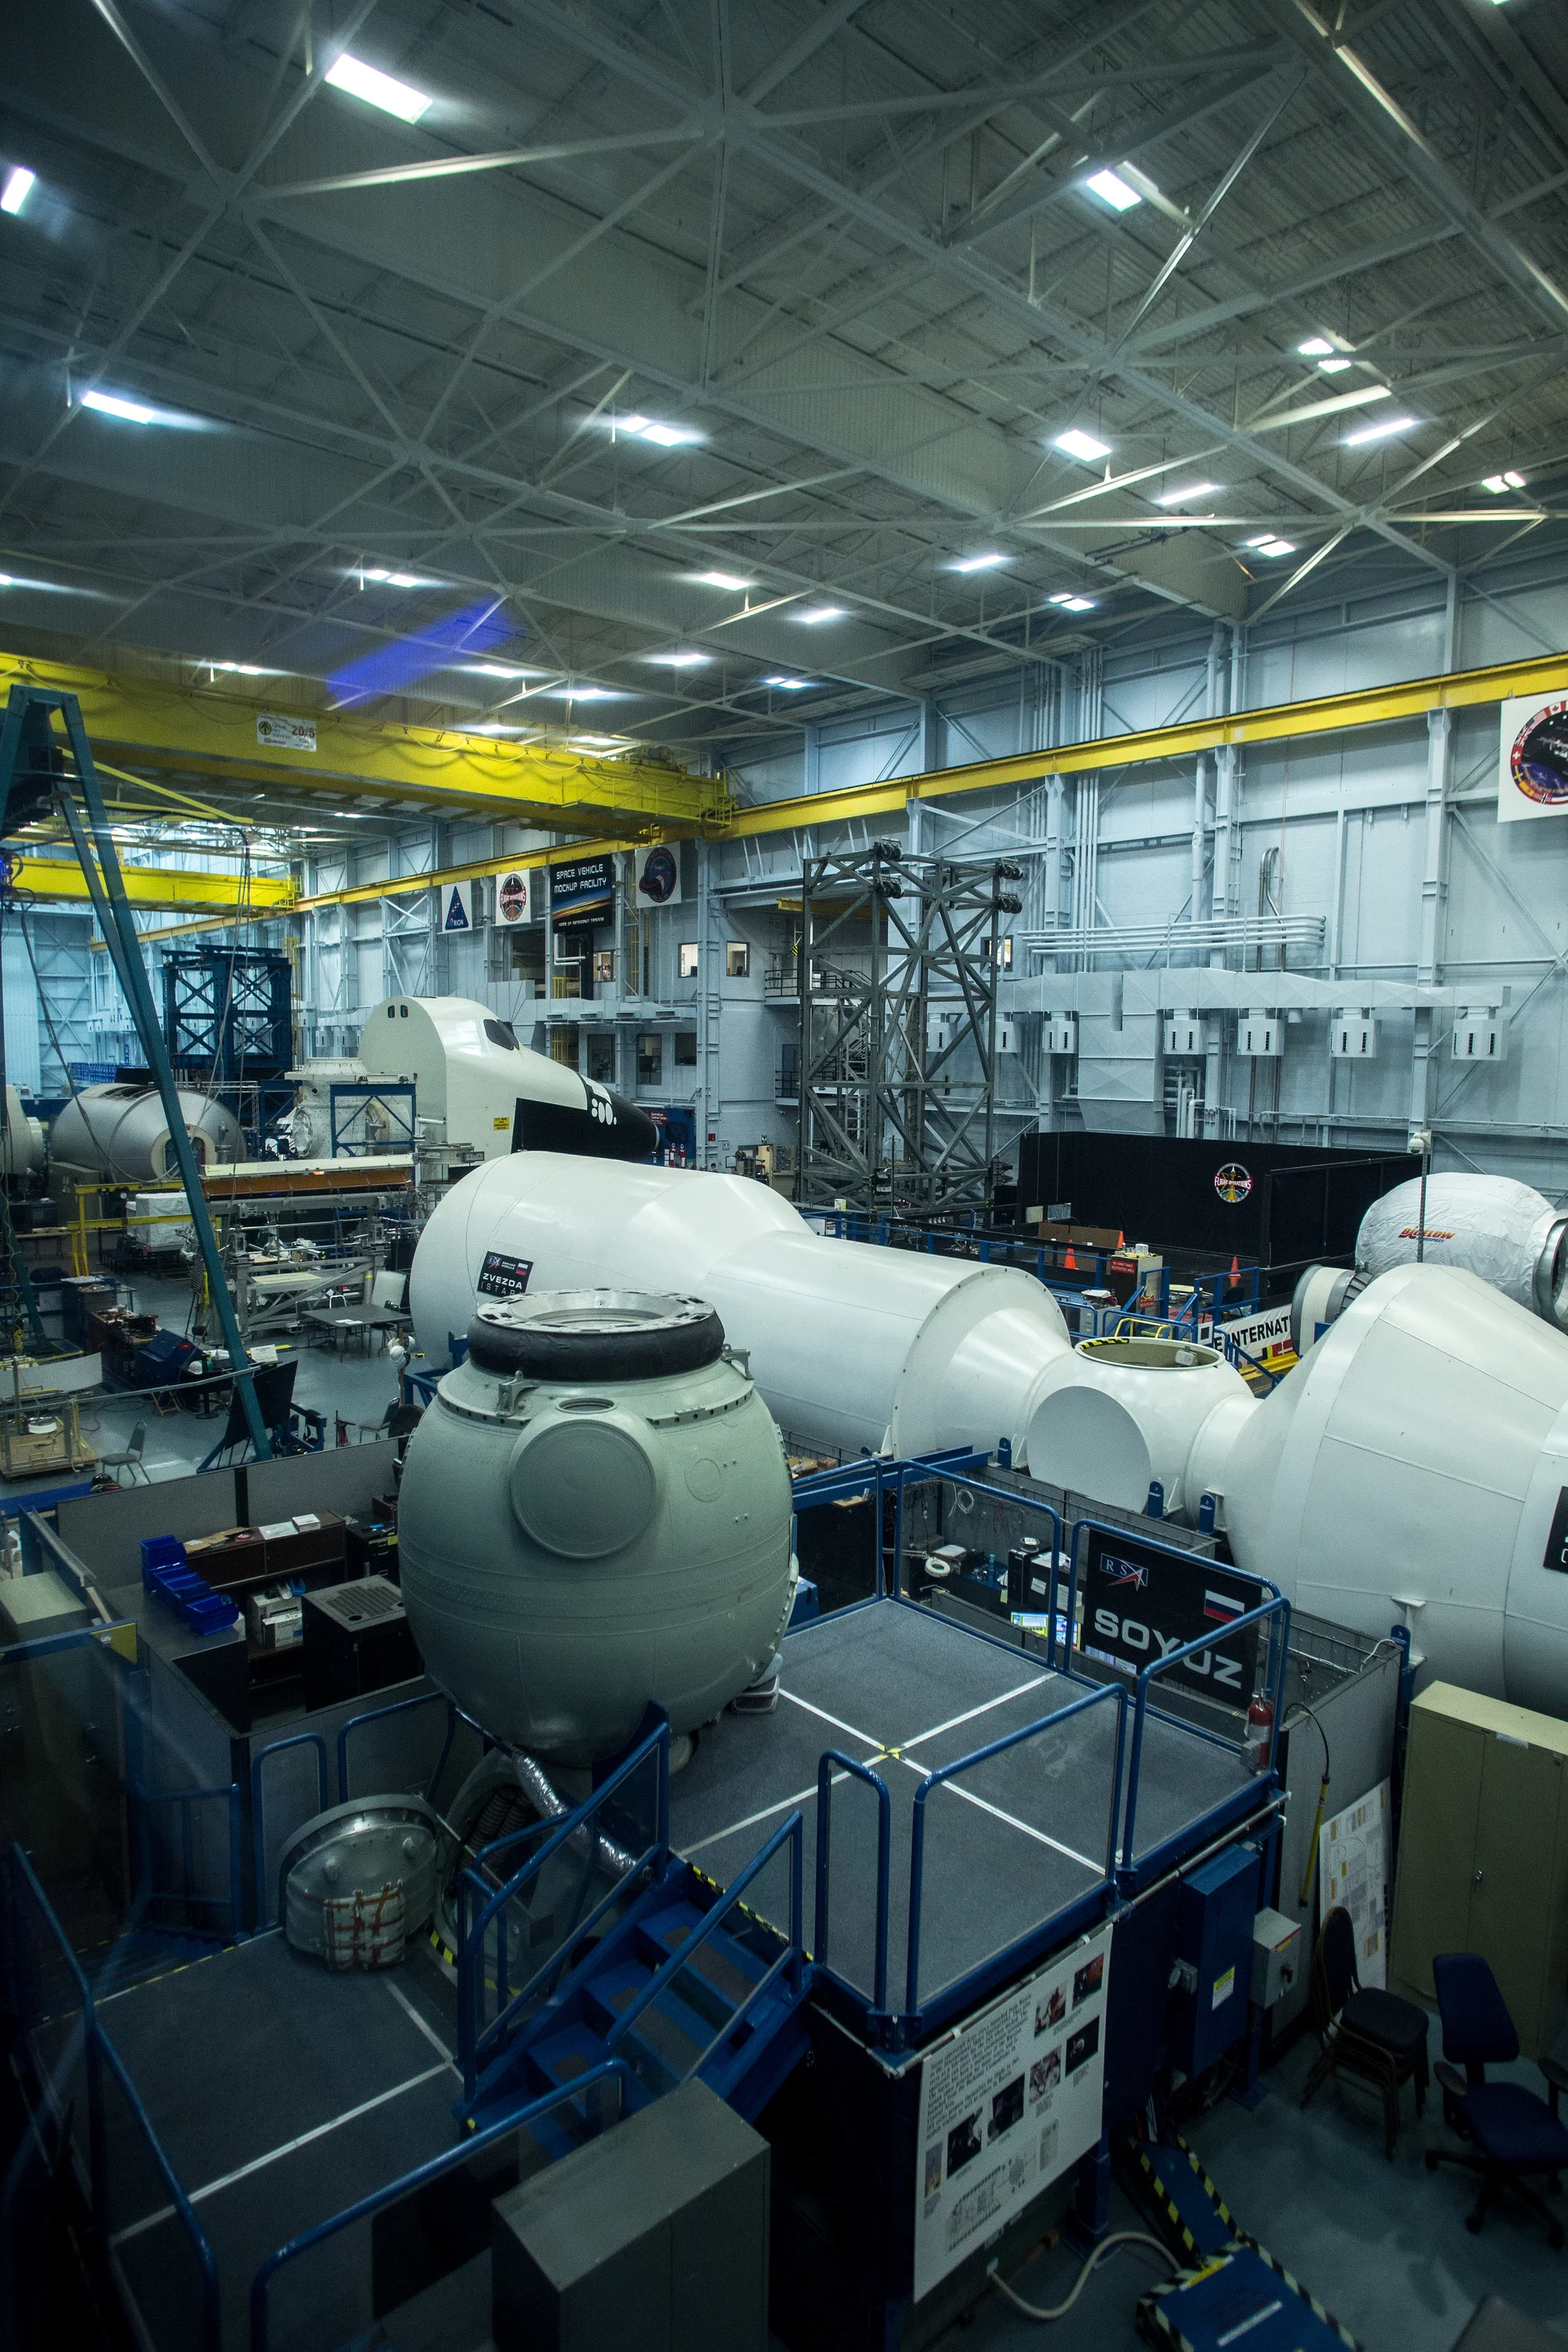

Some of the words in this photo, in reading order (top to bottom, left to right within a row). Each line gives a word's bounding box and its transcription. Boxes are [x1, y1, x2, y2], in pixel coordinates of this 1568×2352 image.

[292, 725, 315, 738] 20/5
[556, 869, 575, 880] SPACE
[577, 864, 604, 876] VEHICLE
[554, 882, 577, 893] MOCKUP
[580, 877, 607, 889] FACILITY
[1214, 1176, 1228, 1187] FLIGHT
[1228, 1179, 1251, 1190] OPERATIONS
[483, 1272, 523, 1290] ZVEZDA
[1227, 1315, 1291, 1348] INTERNAT
[1094, 1608, 1243, 1690] SOYUZ
